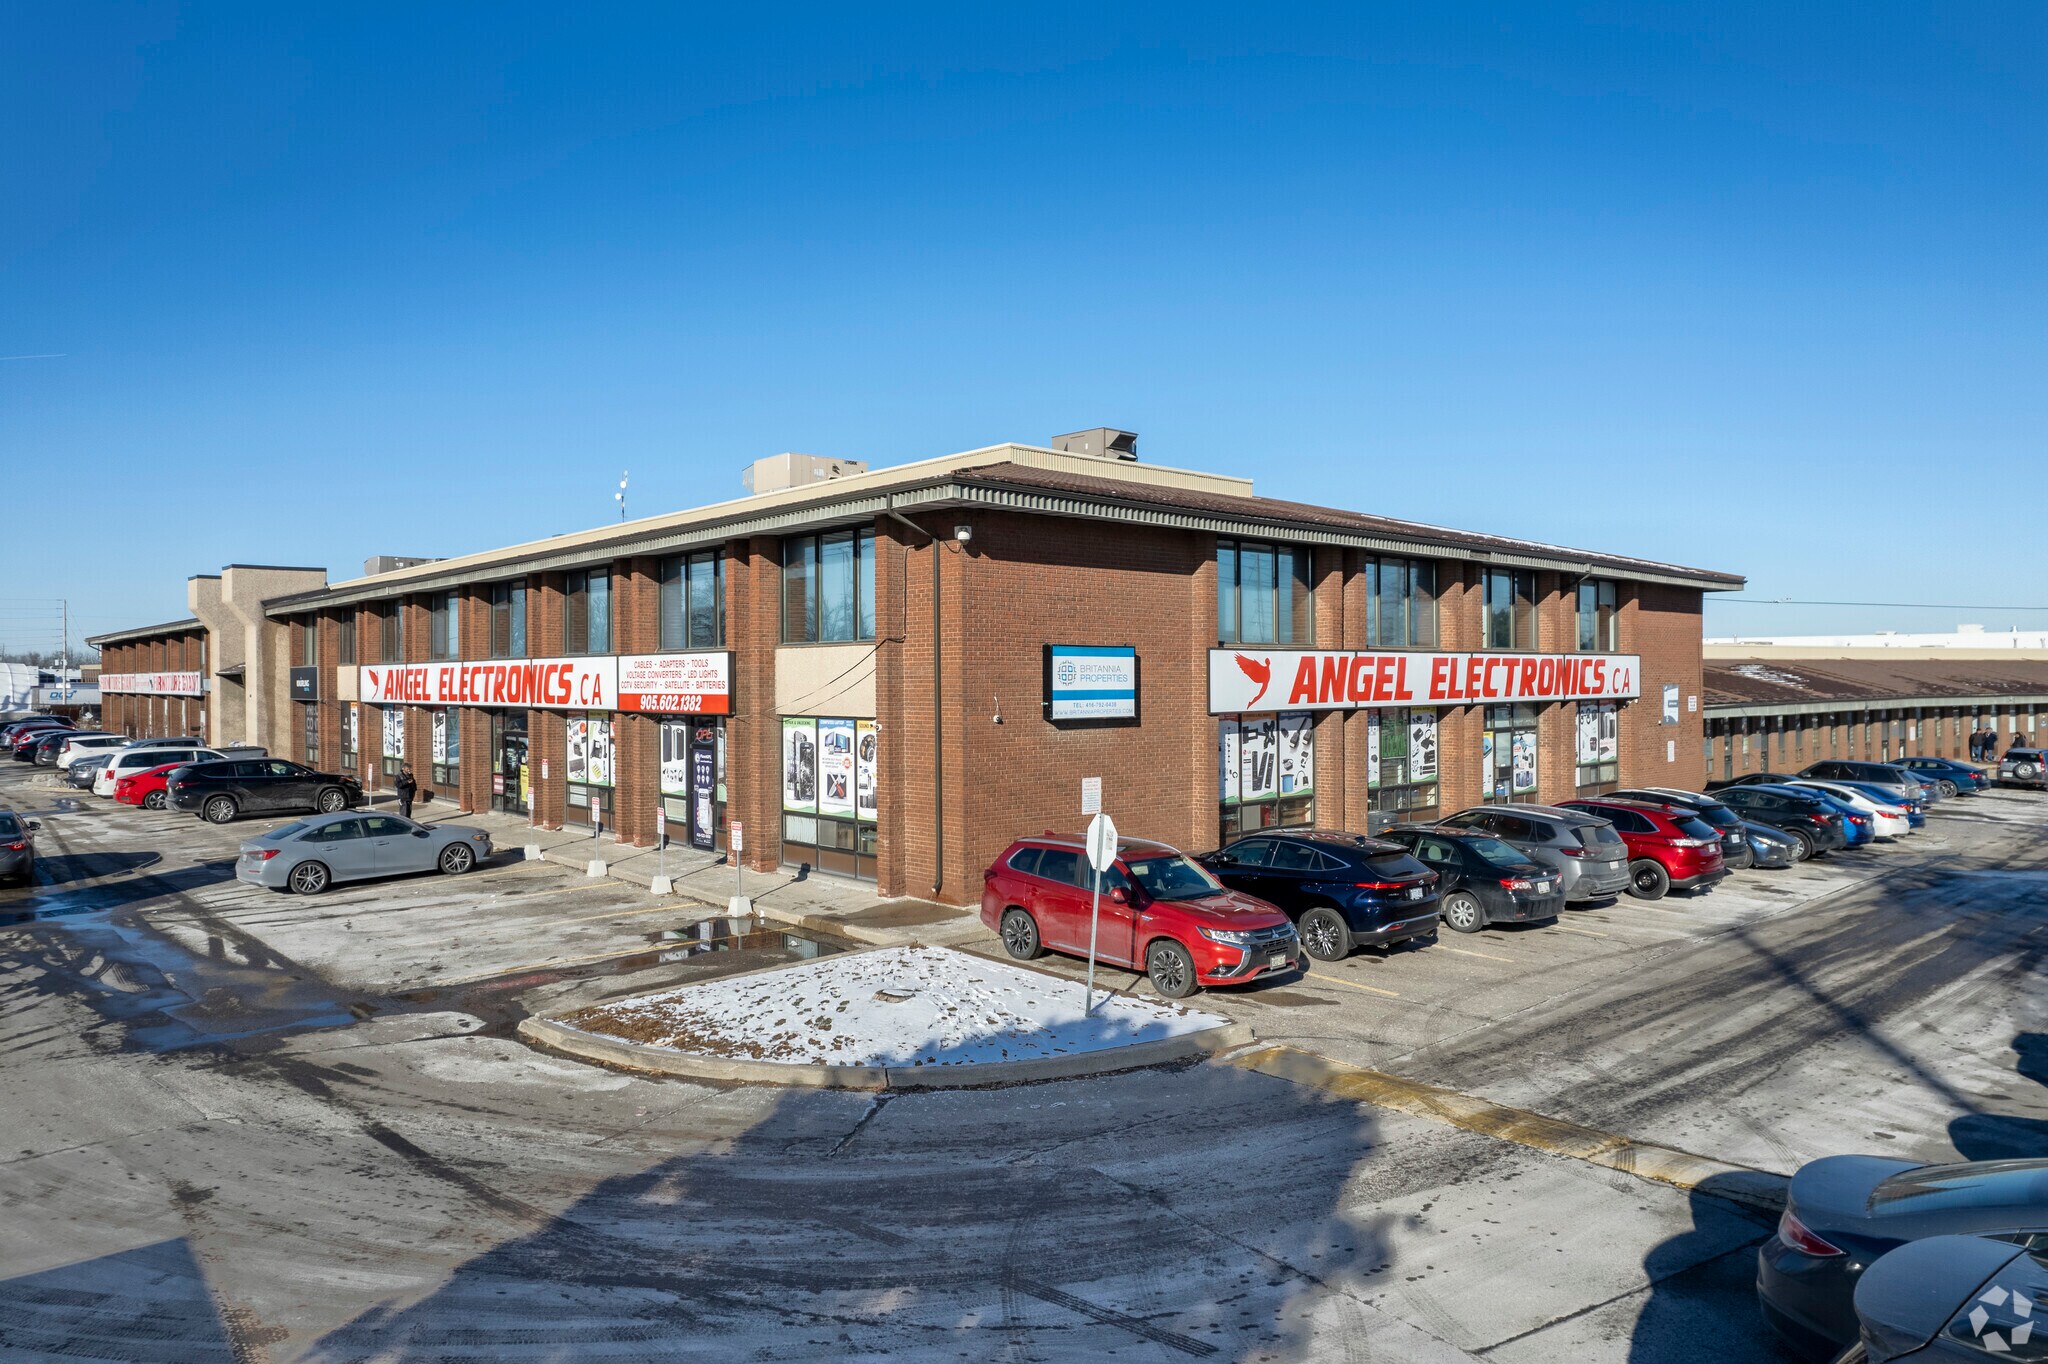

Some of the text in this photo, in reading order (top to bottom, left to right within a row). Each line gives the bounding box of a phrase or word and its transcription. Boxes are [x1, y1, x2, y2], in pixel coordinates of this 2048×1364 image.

[634, 659, 709, 669] CABLES ADAPTERS TOOLS
[1080, 665, 1121, 673] BRITANNIA
[626, 669, 718, 679] VOLTAGE CONVERTERS LED LIGHTS
[1080, 674, 1128, 682] PROPERTIES
[181, 674, 199, 692] GIANT
[383, 667, 432, 702] ANGEL
[620, 680, 726, 689] CCTV SECURITY SATELLITE BATTERIES
[1288, 655, 1413, 705] ANGEL
[640, 695, 702, 711] 905.602.1382
